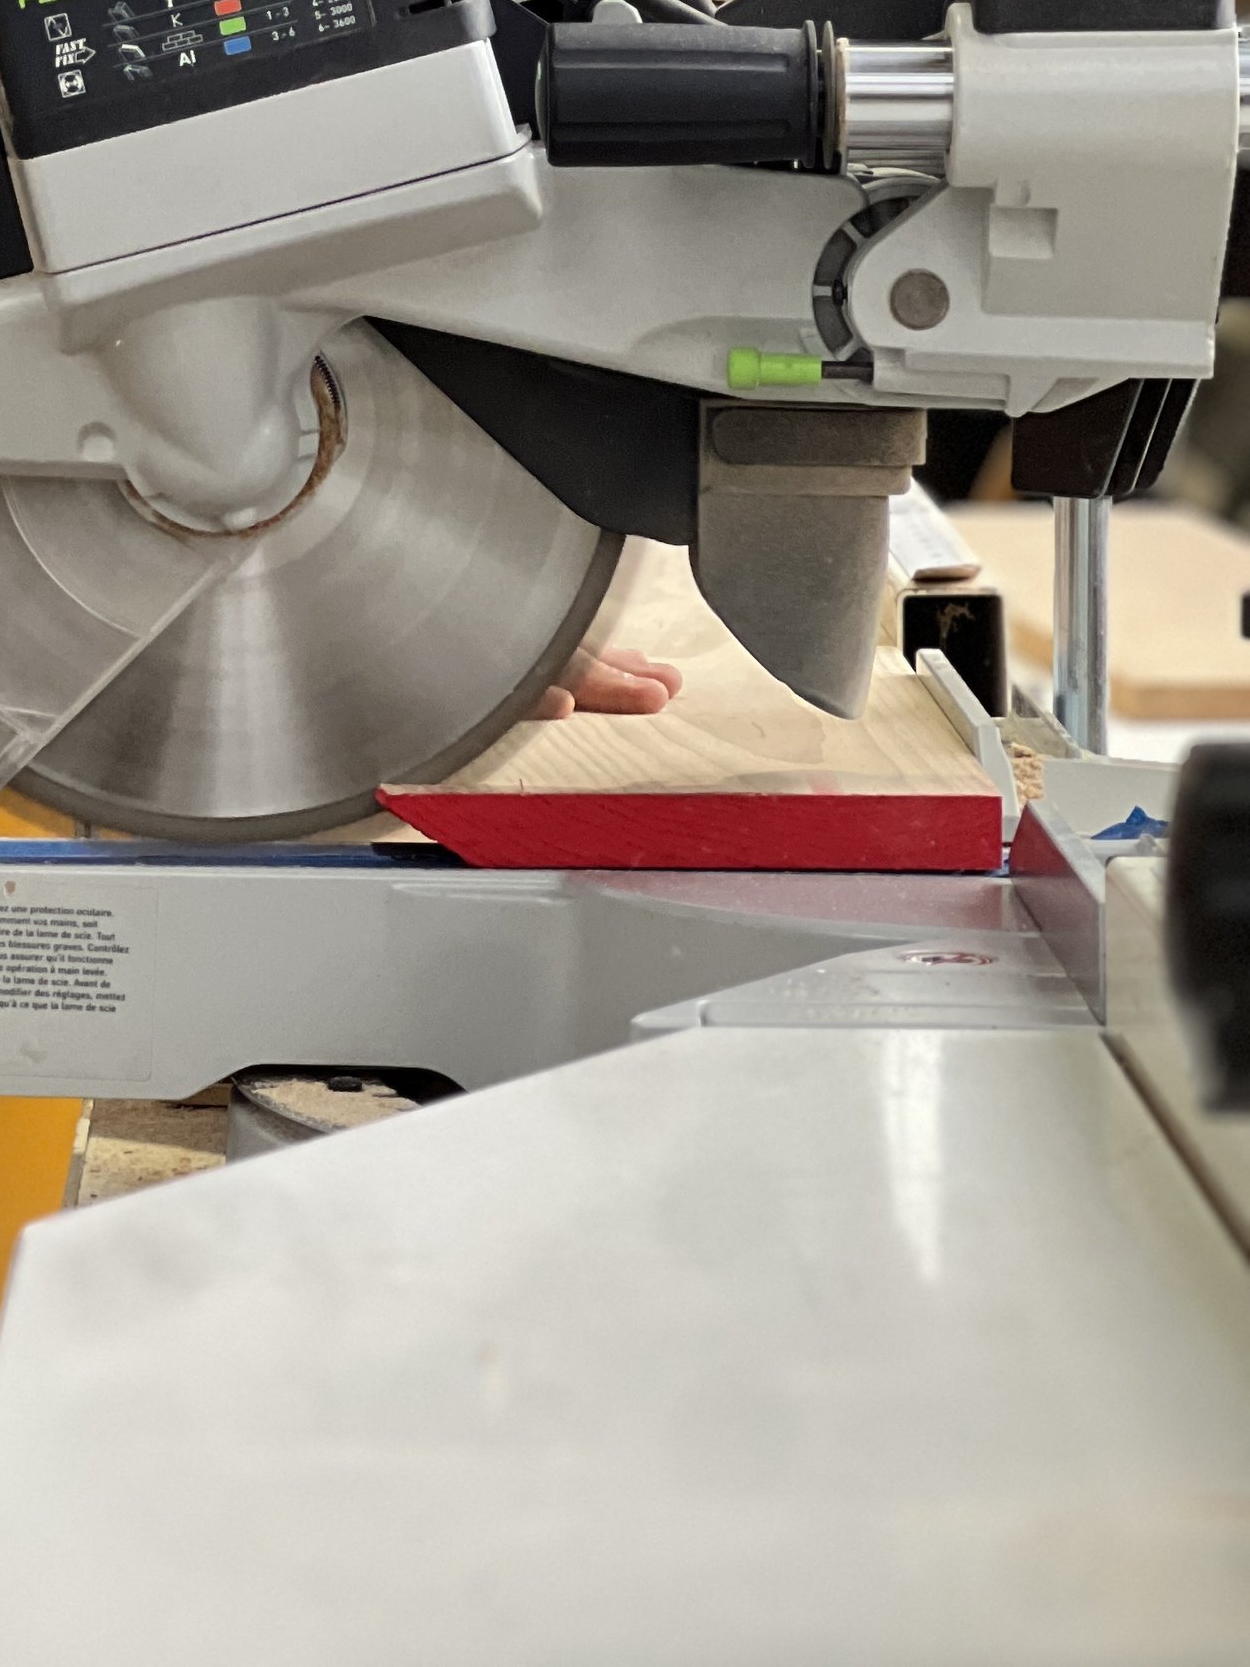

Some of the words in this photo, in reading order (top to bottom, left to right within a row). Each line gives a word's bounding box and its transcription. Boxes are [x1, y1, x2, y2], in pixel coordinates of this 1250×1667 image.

[171, 13, 183, 27] K
[333, 16, 356, 28] 3600
[55, 38, 86, 55] FAST
[55, 52, 76, 68] FIX
